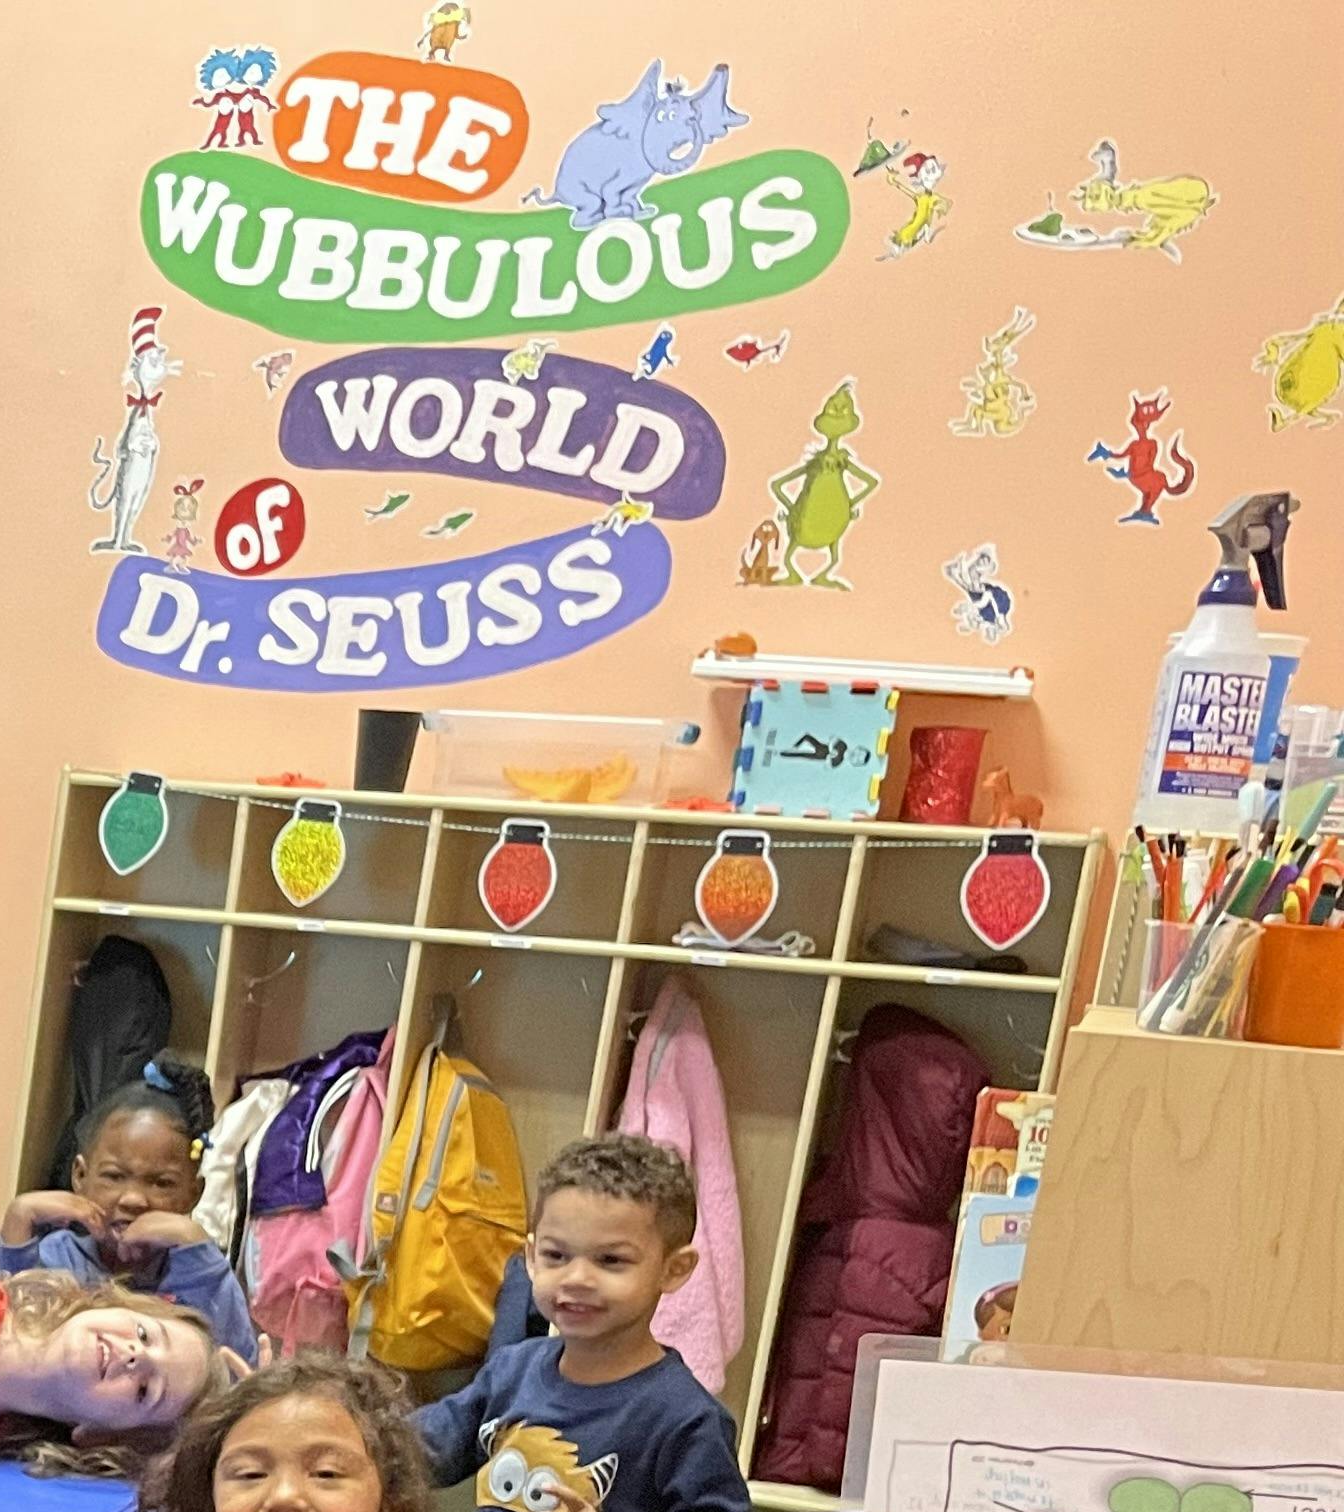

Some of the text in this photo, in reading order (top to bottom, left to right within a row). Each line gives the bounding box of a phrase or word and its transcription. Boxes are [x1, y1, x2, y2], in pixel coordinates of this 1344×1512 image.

[285, 74, 512, 197] THE
[152, 174, 819, 320] WUBBULOUS
[316, 376, 685, 493] WORLD
[120, 537, 624, 676] Dr. SEUSS
